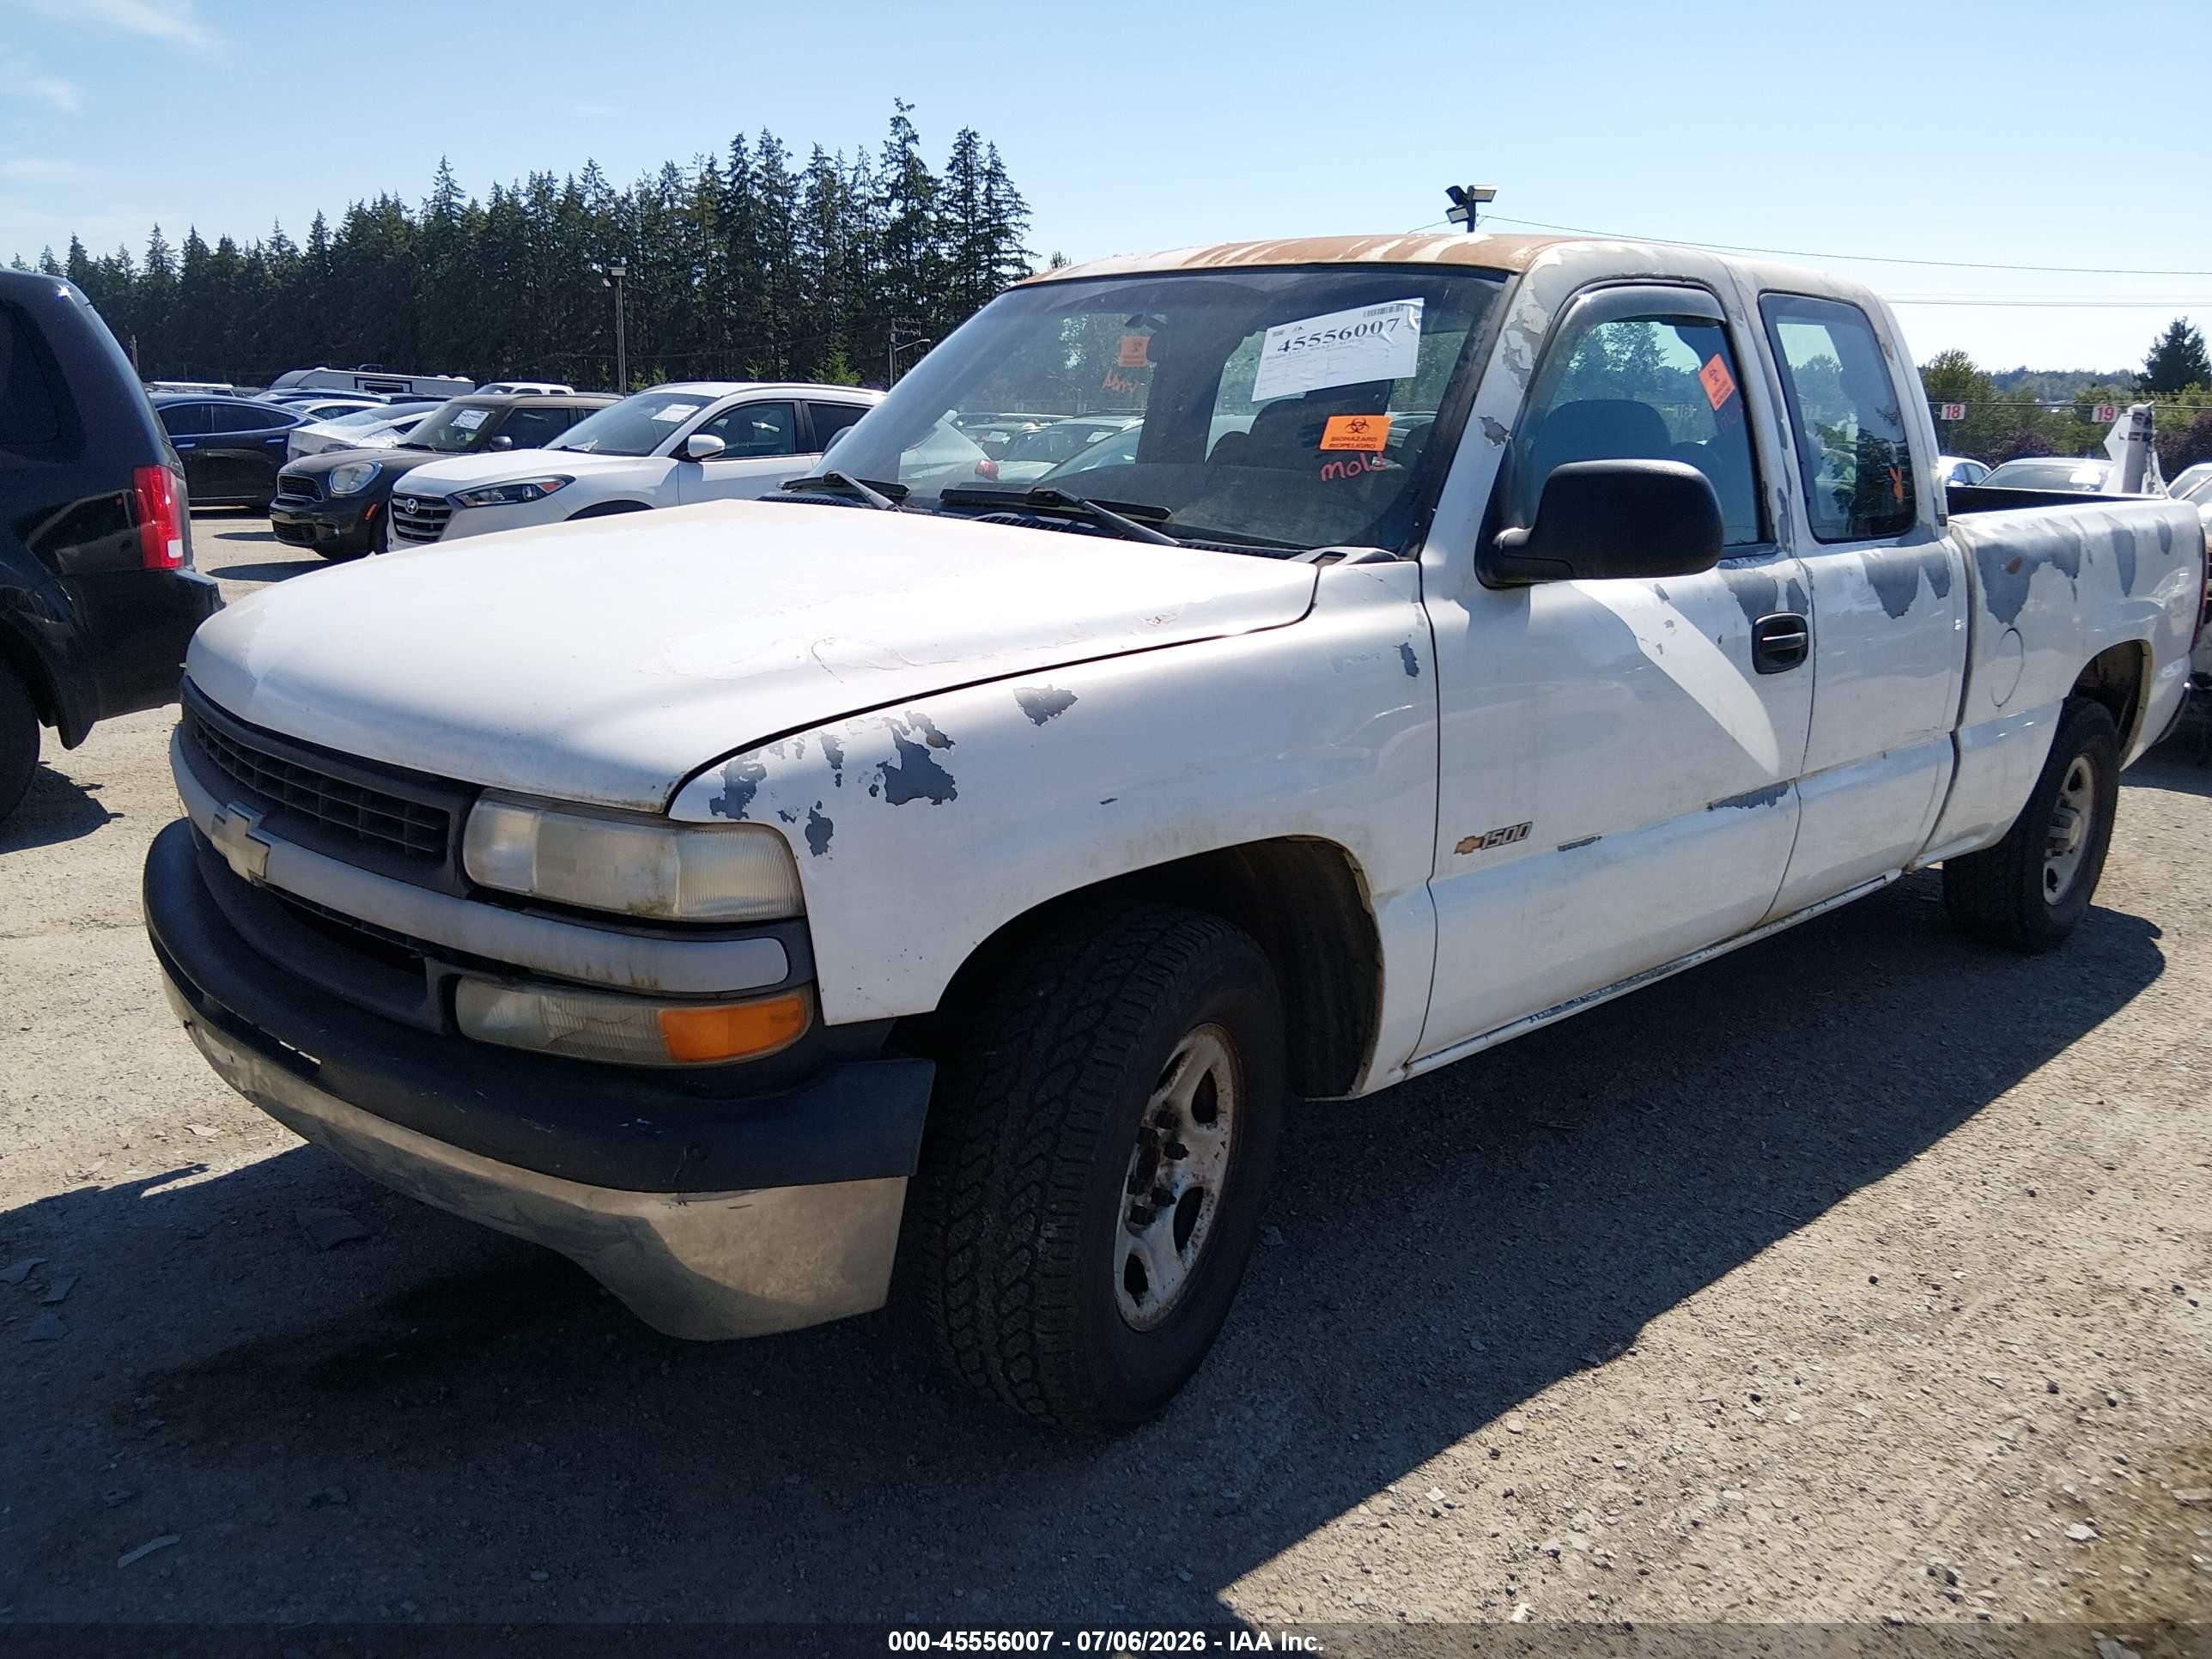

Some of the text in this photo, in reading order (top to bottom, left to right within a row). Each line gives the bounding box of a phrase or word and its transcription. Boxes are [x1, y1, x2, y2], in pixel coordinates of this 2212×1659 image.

[1278, 318, 1401, 353] 45556007
[1945, 404, 1961, 419] 18
[2097, 406, 2114, 421] 19
[1481, 821, 1533, 850] 1500
